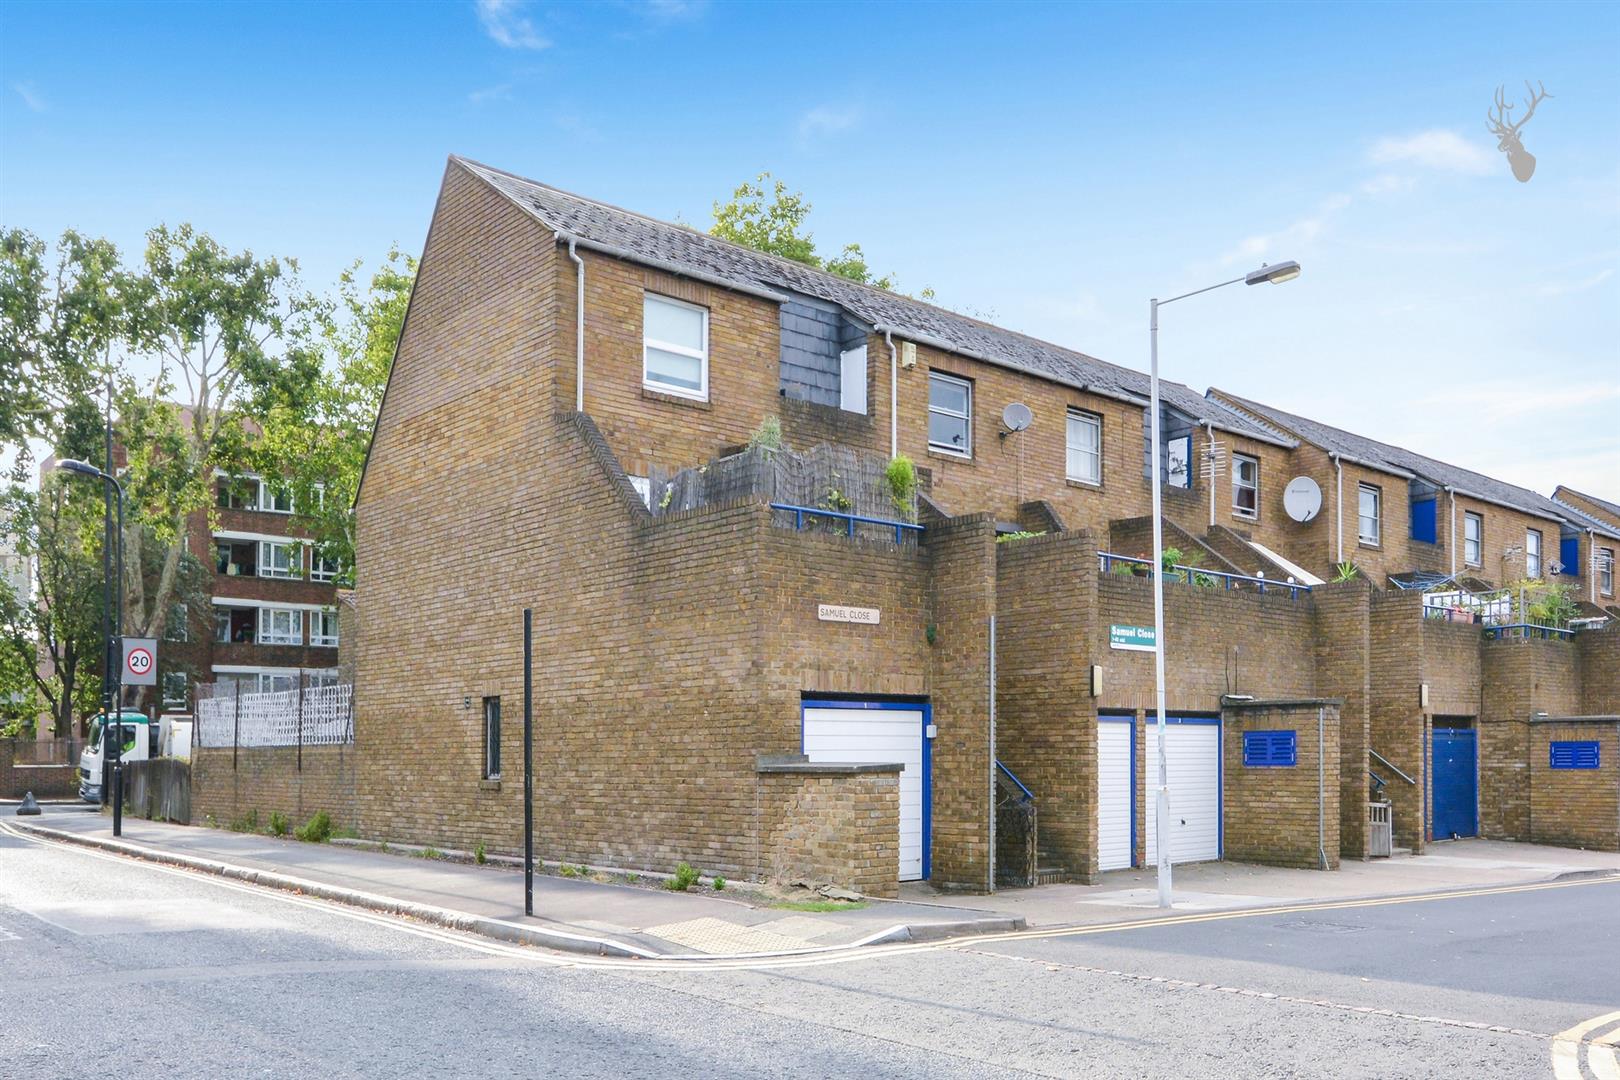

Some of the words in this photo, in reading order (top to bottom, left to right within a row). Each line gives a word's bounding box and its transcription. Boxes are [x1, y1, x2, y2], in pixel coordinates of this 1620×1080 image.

[820, 608, 847, 618] SAMUEL
[849, 610, 870, 620] CLOSE
[1111, 625, 1136, 637] Samuel
[131, 656, 149, 667] 20
